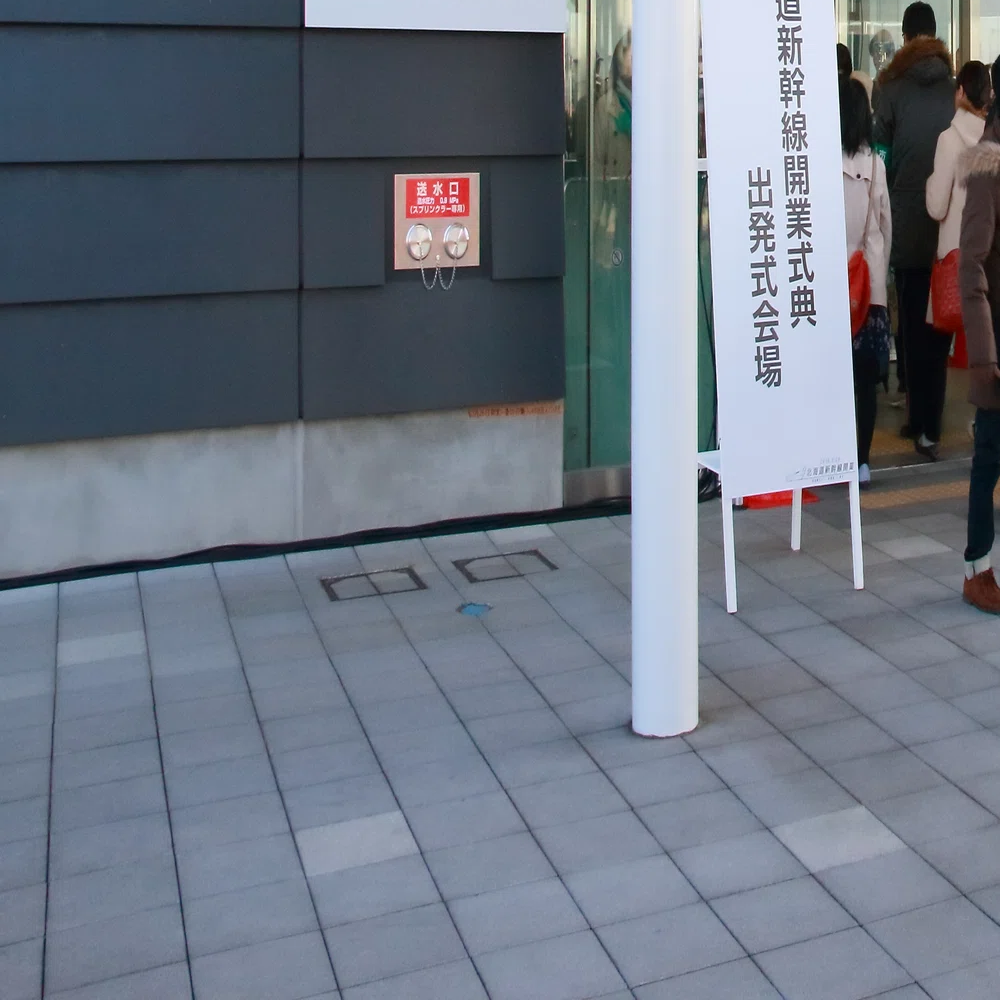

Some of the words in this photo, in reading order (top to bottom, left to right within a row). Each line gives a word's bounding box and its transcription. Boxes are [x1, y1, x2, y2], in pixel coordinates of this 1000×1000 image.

[417, 181, 459, 196] 送水口
[747, 166, 783, 388] 出発式会場
